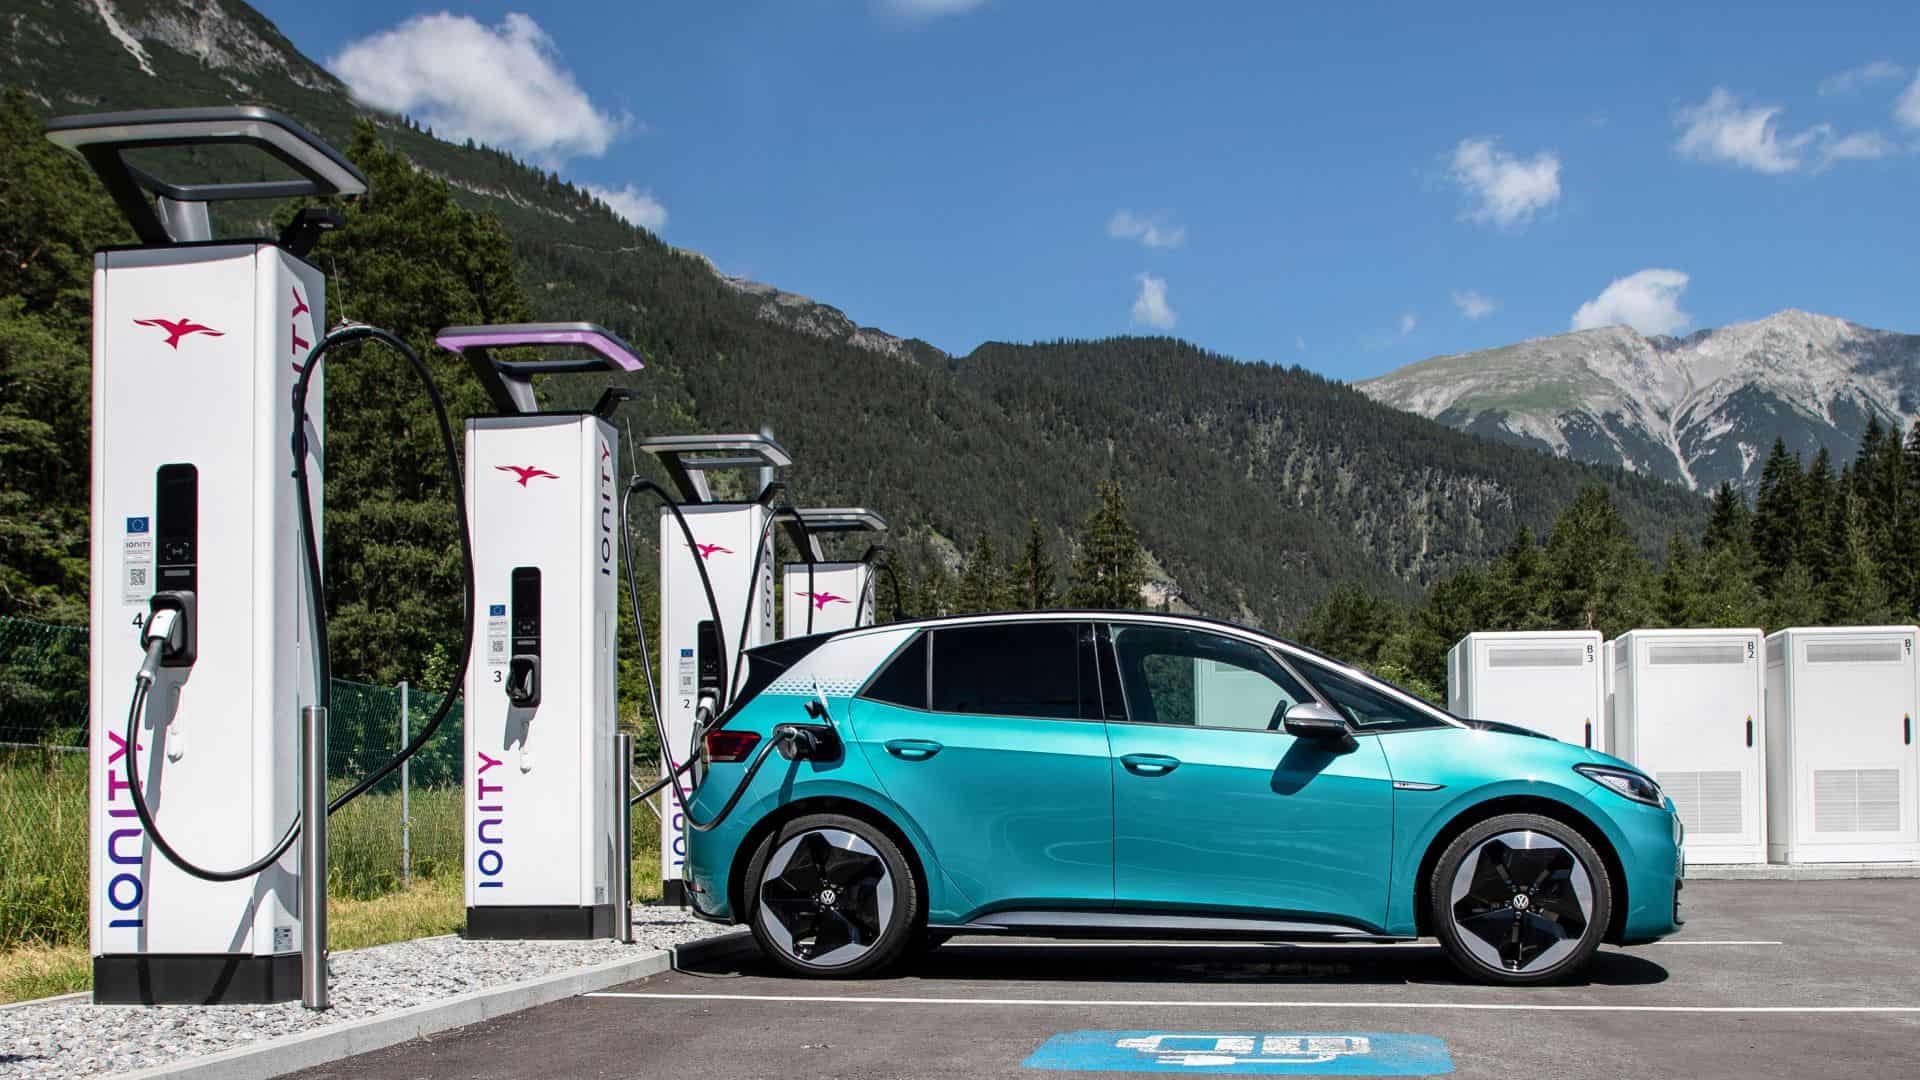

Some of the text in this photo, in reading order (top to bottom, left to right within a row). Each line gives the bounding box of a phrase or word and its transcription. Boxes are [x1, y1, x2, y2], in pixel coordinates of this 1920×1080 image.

[601, 440, 611, 576] IONITY
[132, 612, 144, 629] 4
[493, 670, 502, 683] 3
[684, 699, 692, 709] 2
[108, 731, 144, 927] IONITY
[478, 752, 504, 887] IONITY
